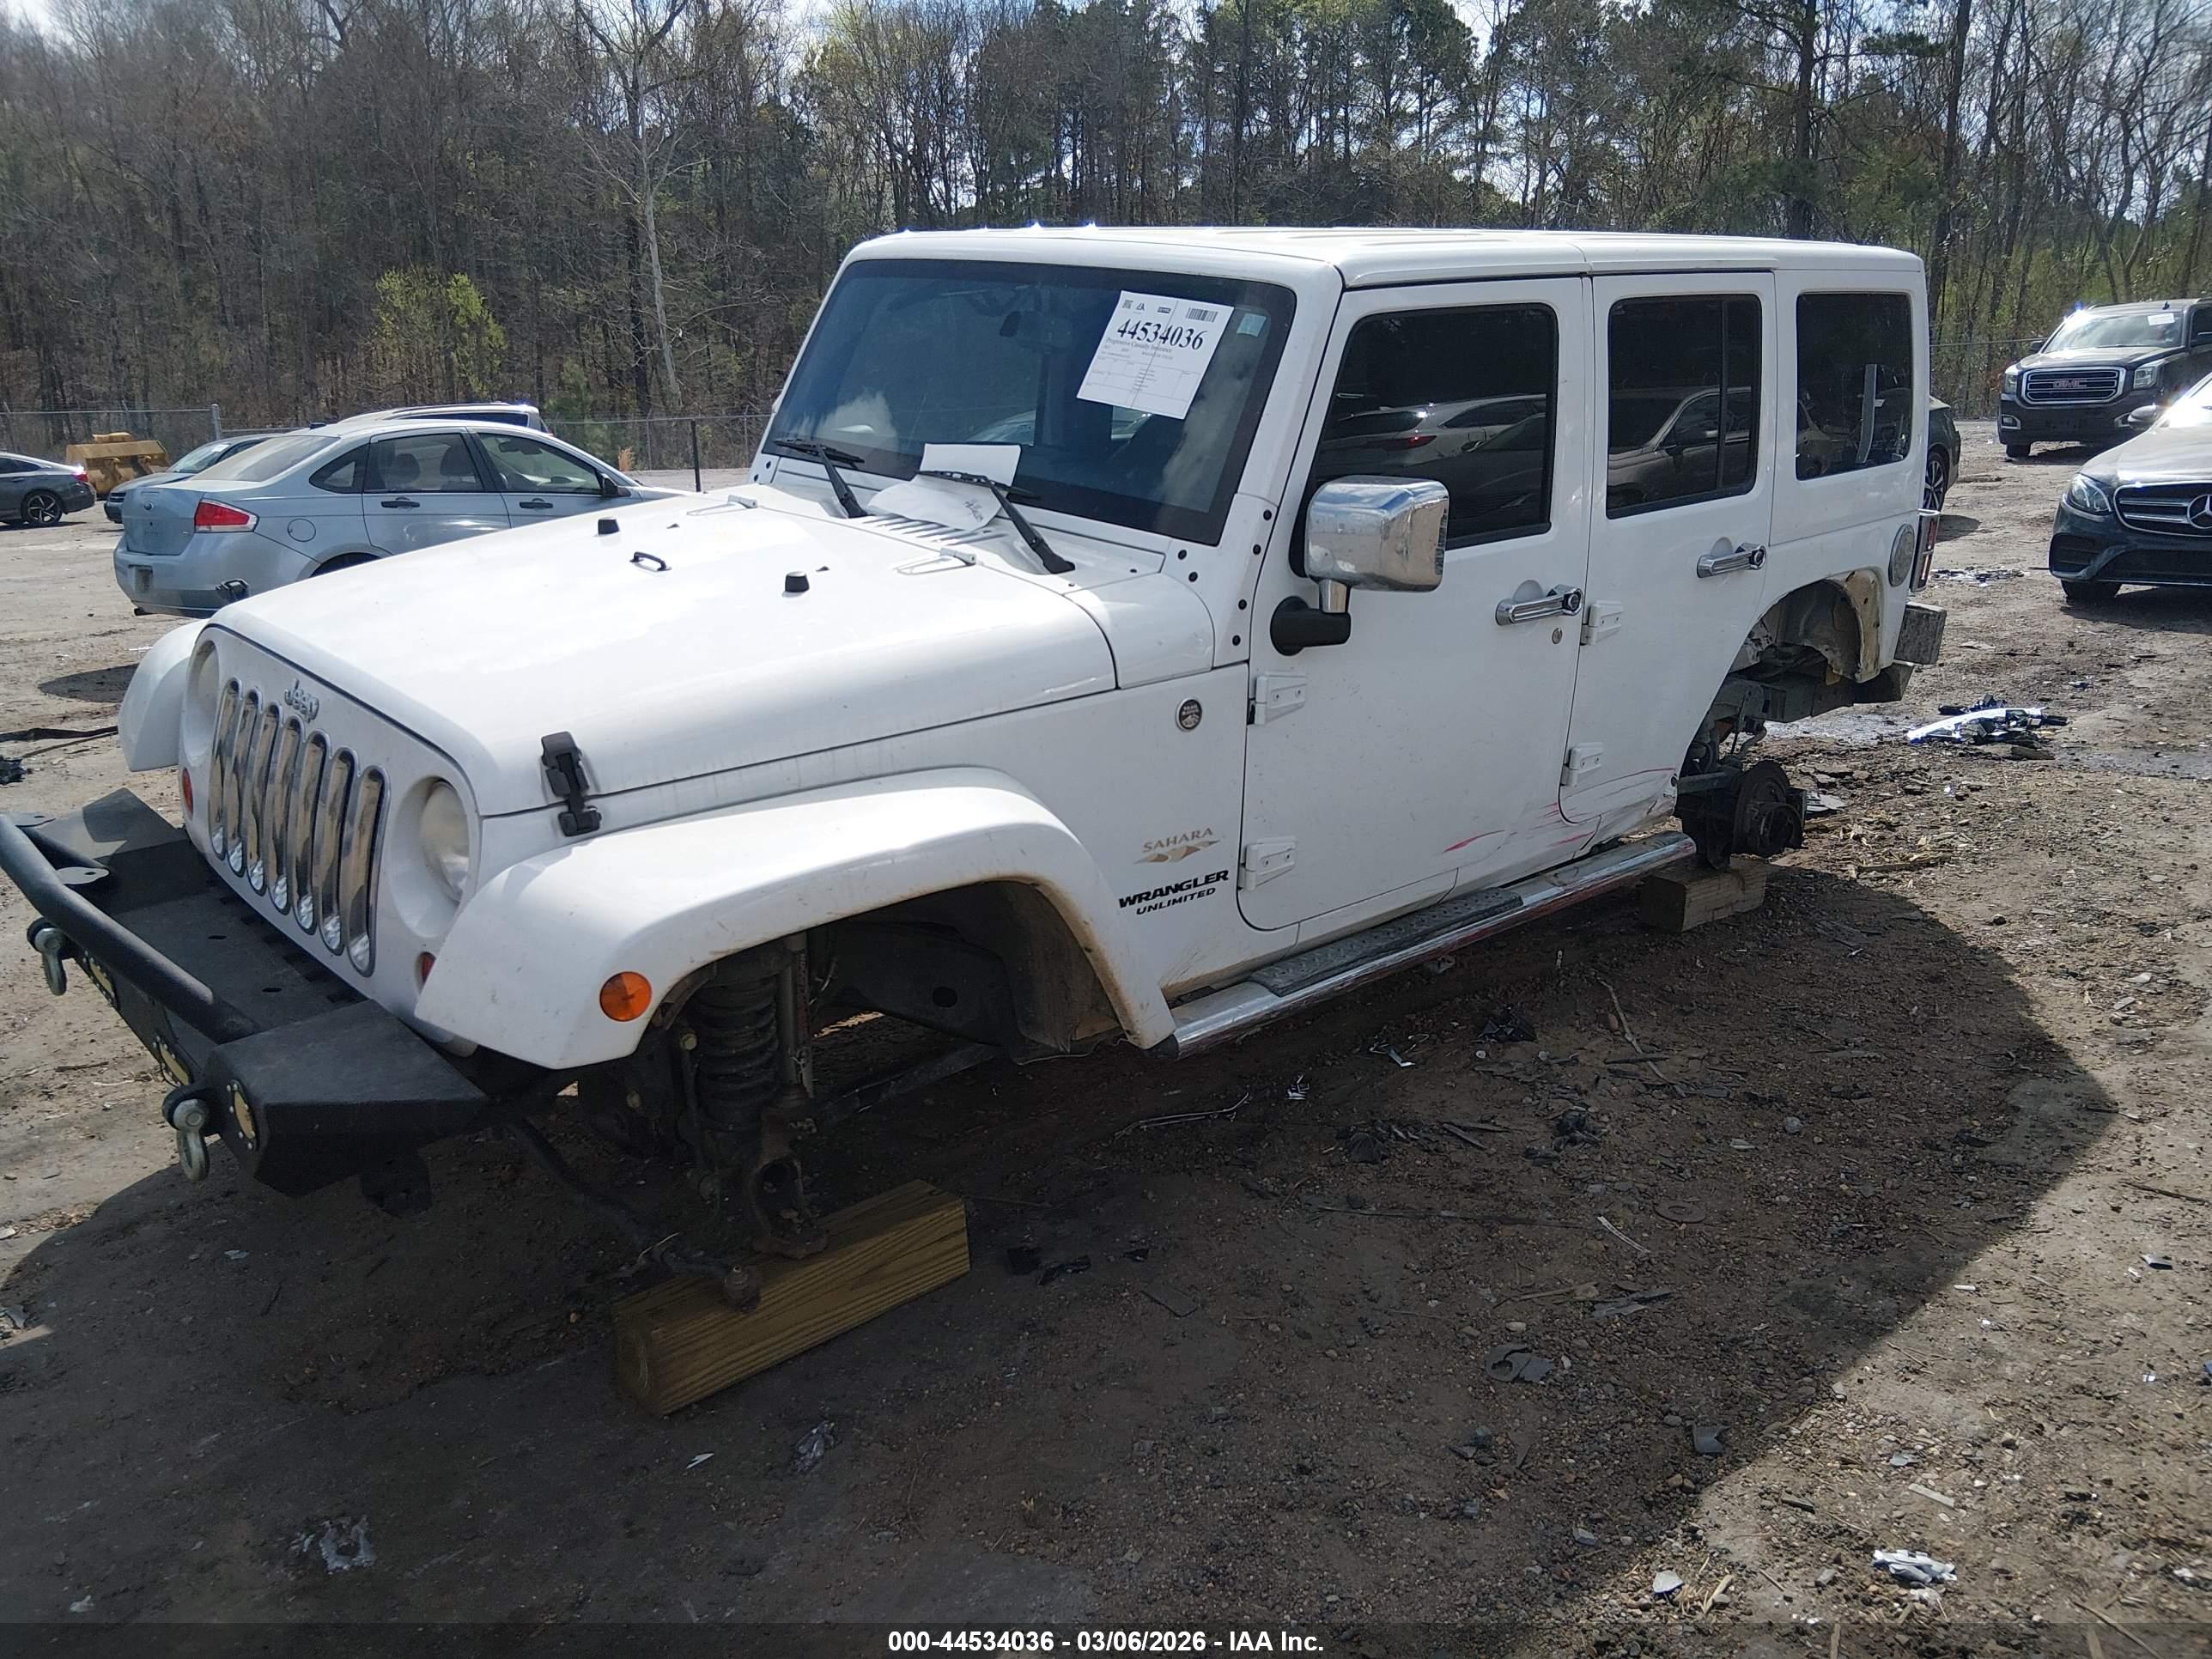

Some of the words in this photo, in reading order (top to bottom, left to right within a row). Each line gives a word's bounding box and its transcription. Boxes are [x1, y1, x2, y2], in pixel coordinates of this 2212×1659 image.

[1117, 319, 1208, 350] 44534036
[284, 679, 319, 723] Jeep
[1142, 827, 1213, 854] SAHARA
[1118, 869, 1230, 908] WRANGLER
[1136, 887, 1216, 915] UNLIMITED
